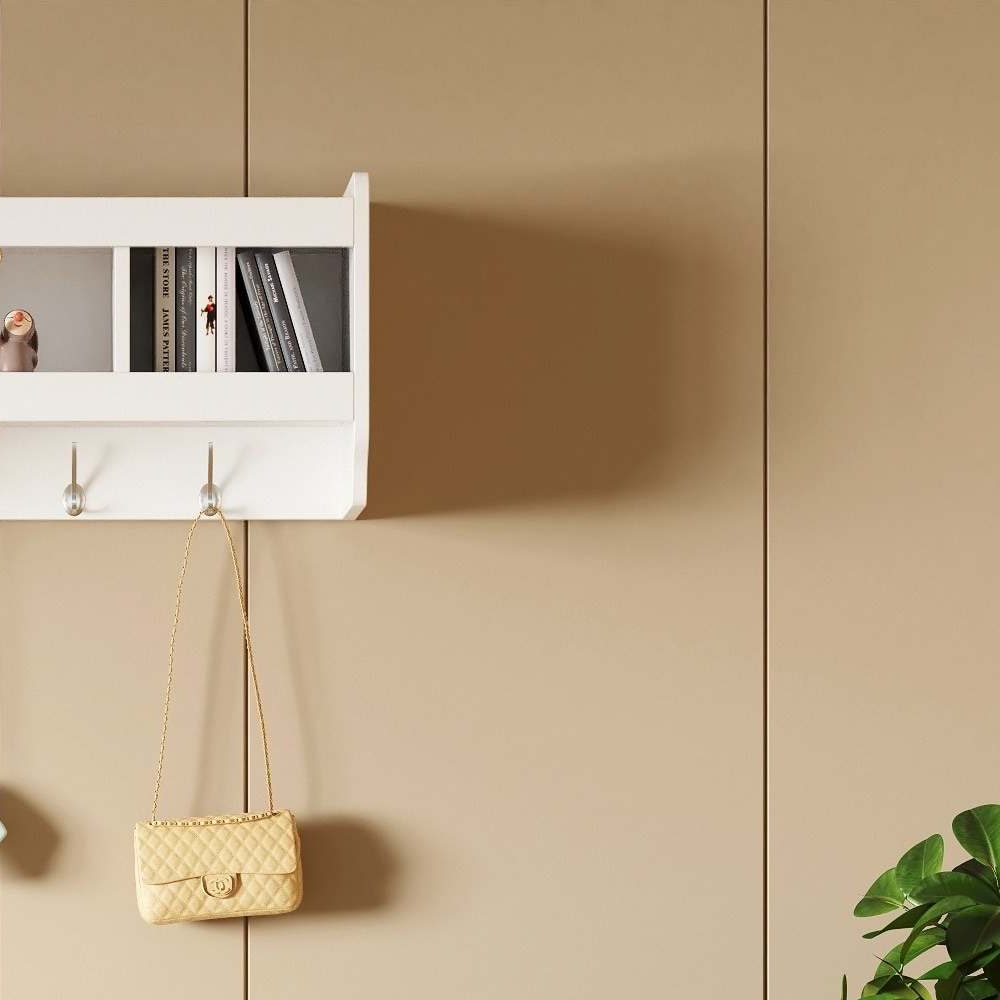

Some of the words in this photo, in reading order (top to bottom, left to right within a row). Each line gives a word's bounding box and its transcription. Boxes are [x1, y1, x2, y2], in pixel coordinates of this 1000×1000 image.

[162, 247, 170, 266] THE
[162, 269, 170, 298] STORE
[179, 281, 188, 305] Origins
[162, 308, 170, 337] JAMES
[179, 307, 188, 316] of
[180, 316, 188, 328] Our
[162, 340, 170, 372] PATTER
[180, 329, 188, 369] Discontents
